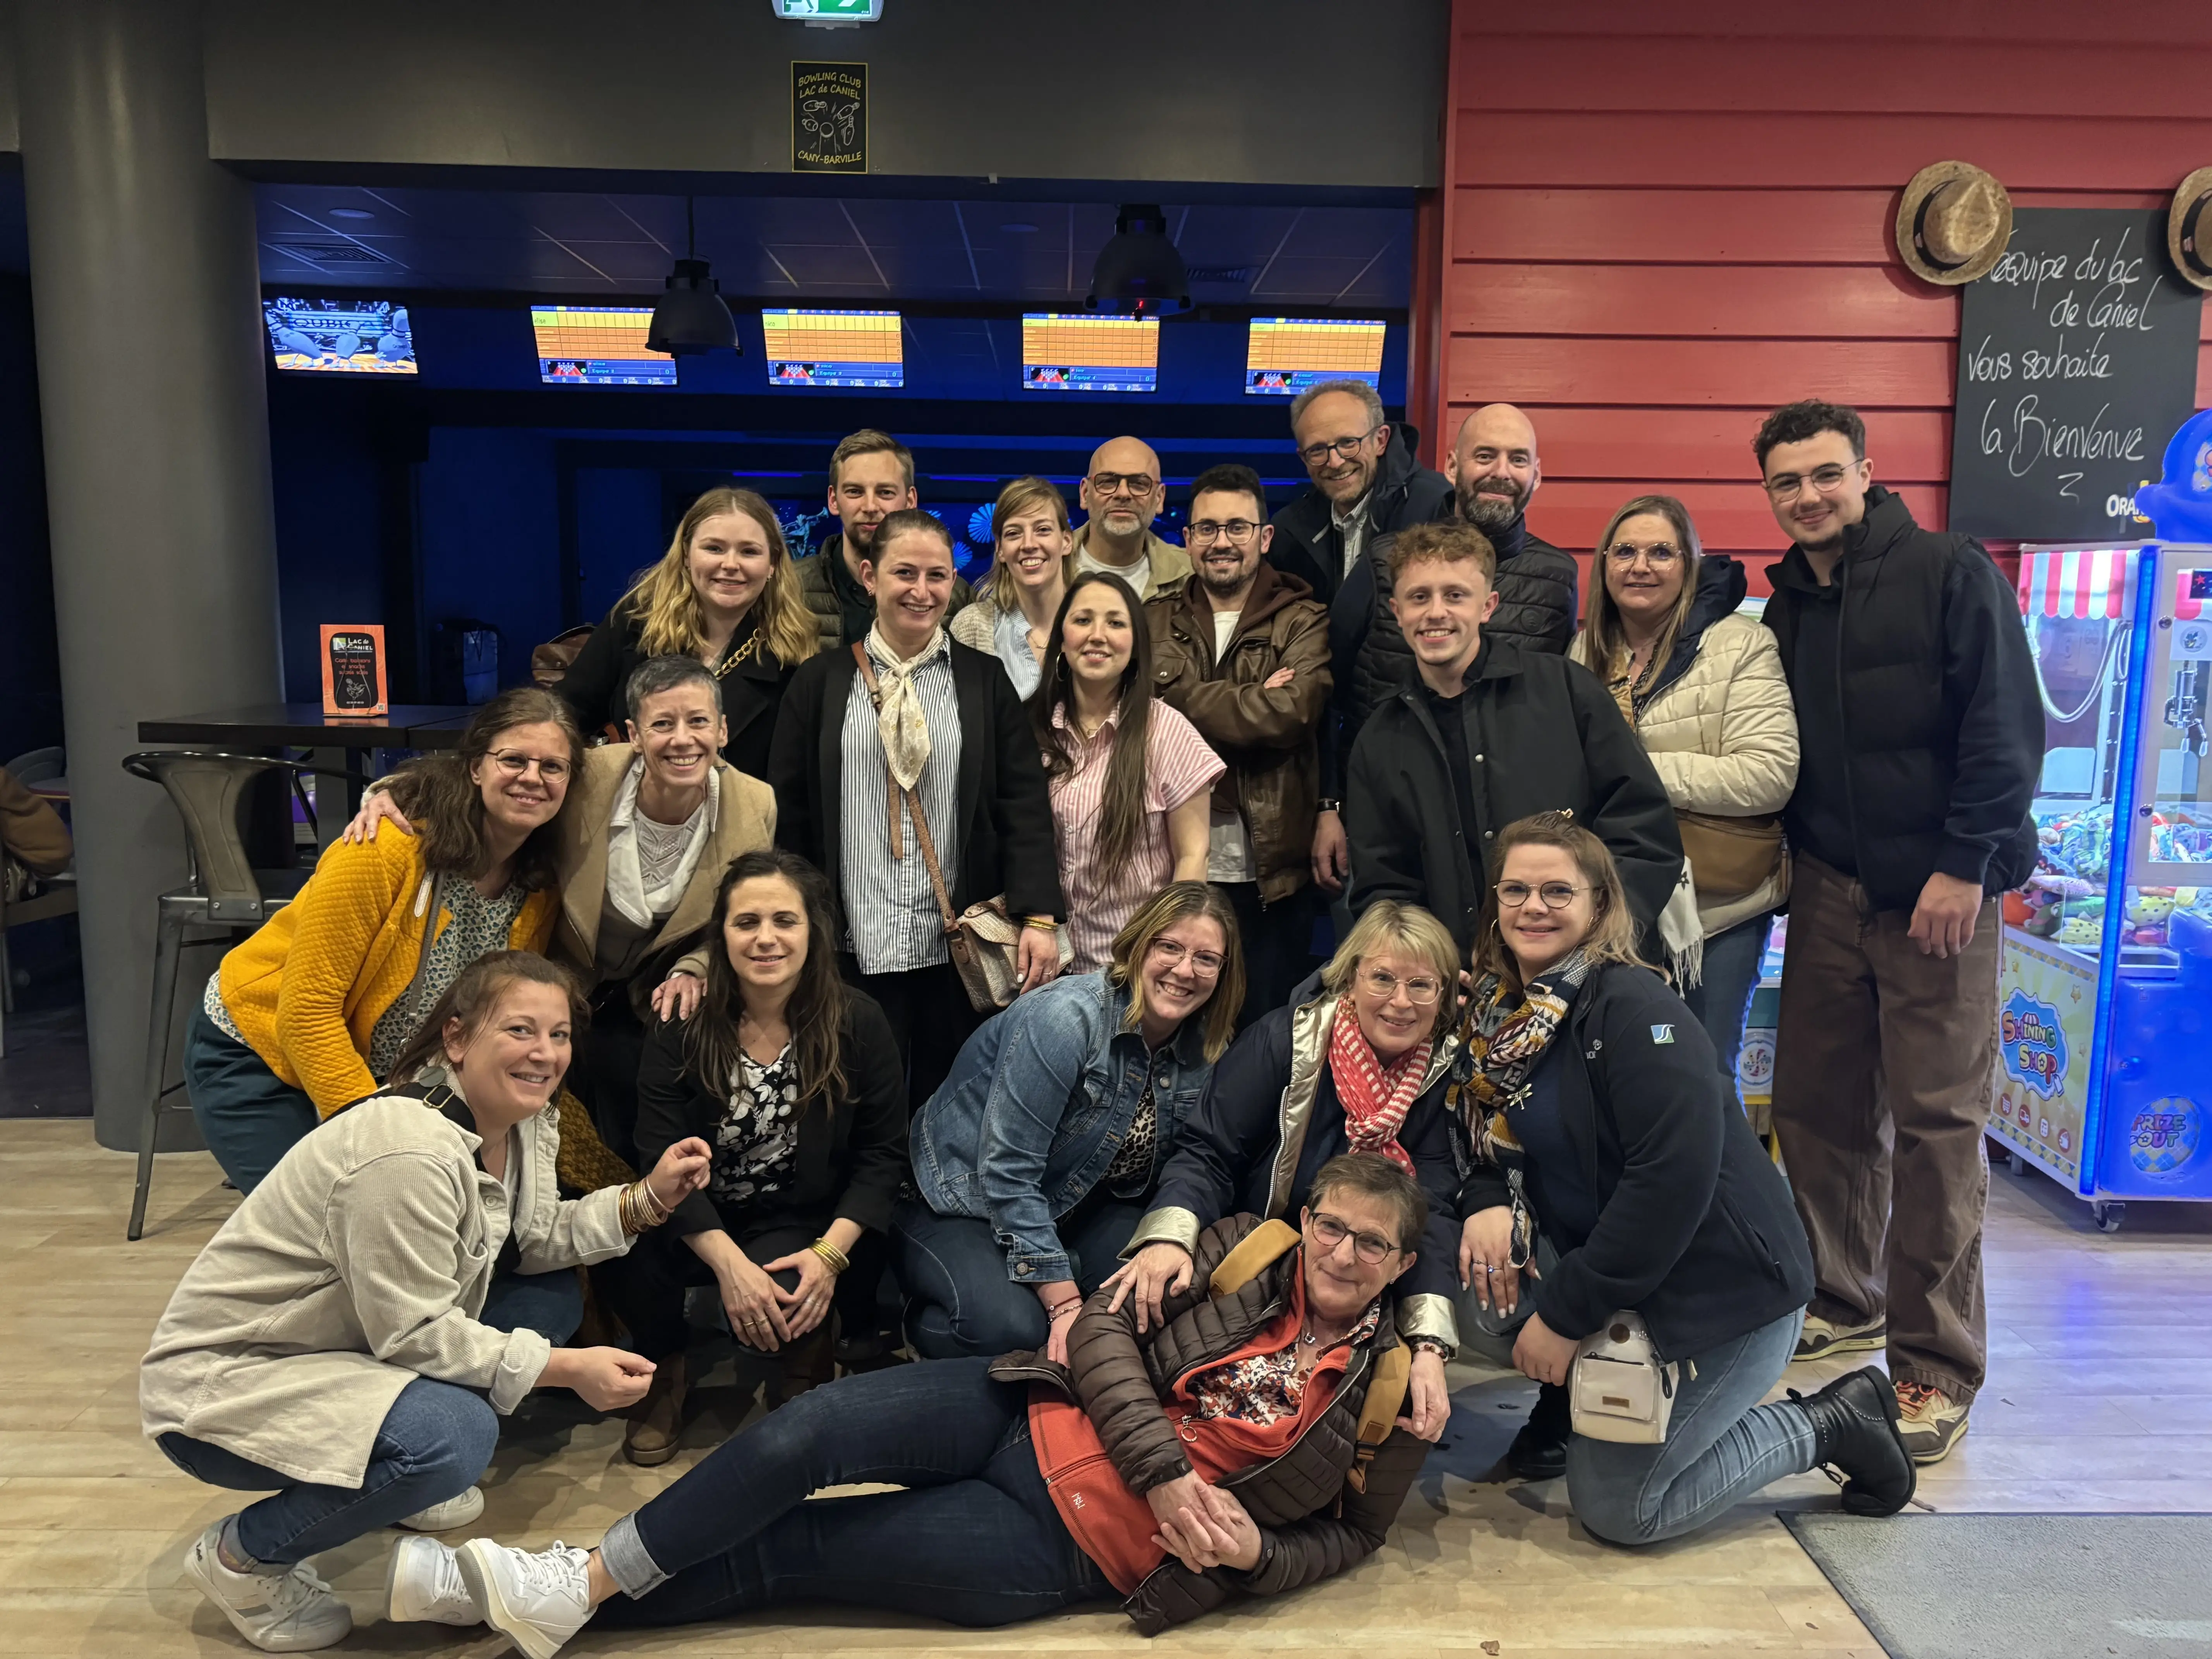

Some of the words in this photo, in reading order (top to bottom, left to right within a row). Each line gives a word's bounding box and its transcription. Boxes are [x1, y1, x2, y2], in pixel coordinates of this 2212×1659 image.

[798, 72, 836, 87] BOWLING
[840, 74, 861, 88] CLUB
[799, 85, 816, 98] LAC
[818, 84, 828, 93] de
[830, 85, 860, 100] CANIEL
[798, 150, 862, 164] CANY-BARVILLE
[2050, 290, 2079, 327] de
[2002, 1010, 2057, 1048] SHINING
[2019, 1043, 2057, 1085] SHOP
[2132, 1114, 2186, 1131] PRIZE
[2137, 1131, 2180, 1148] OUT
